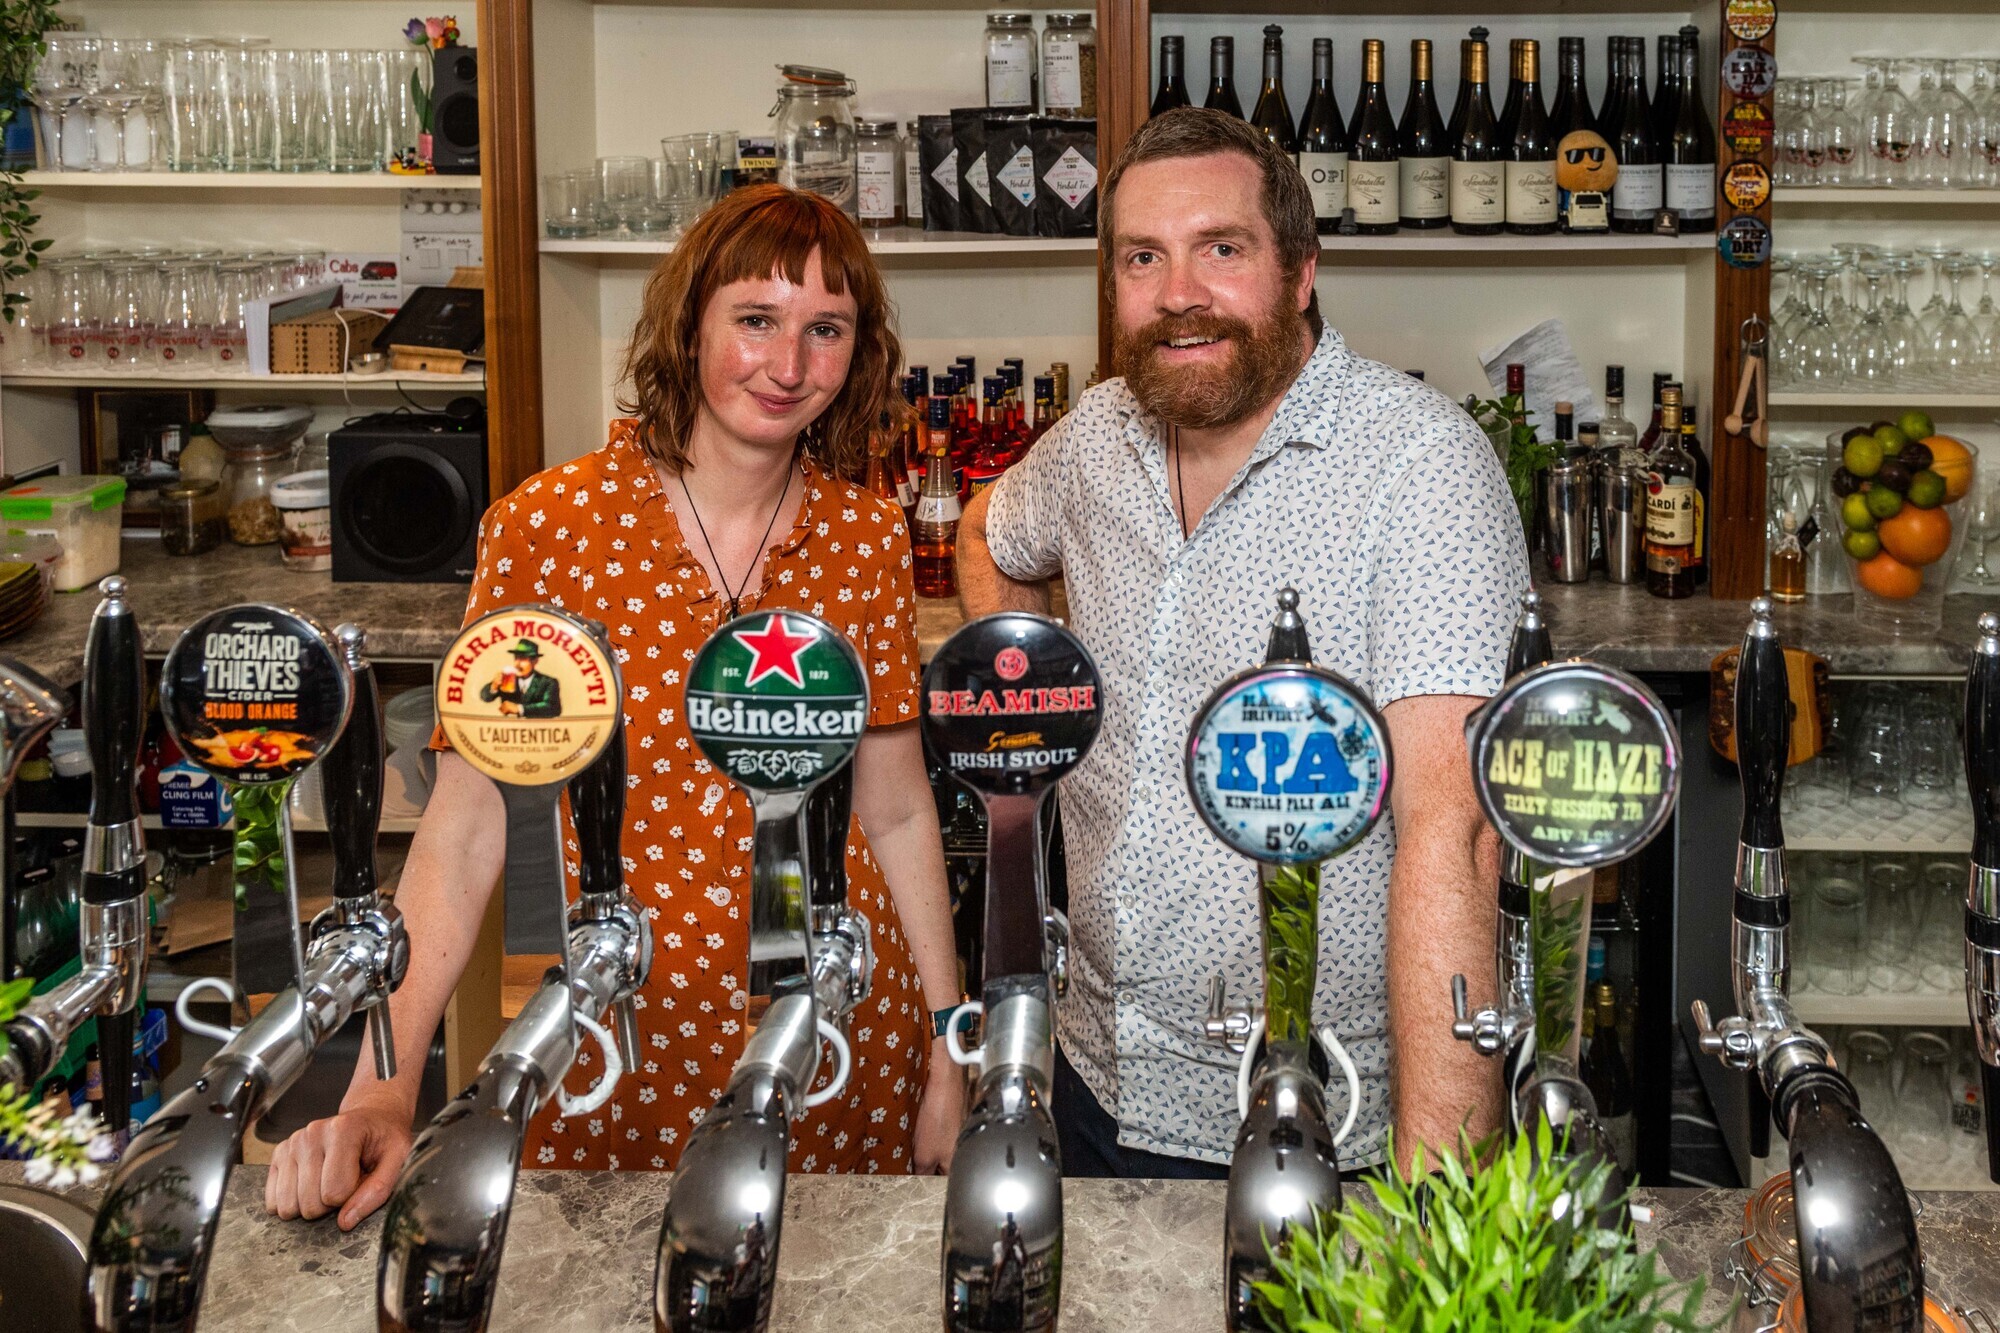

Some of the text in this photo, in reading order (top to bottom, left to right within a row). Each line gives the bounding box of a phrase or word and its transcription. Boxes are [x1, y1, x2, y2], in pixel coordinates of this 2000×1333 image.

[743, 159, 775, 167] TWINING
[1056, 180, 1078, 190] Herbal
[1737, 198, 1755, 206] IPA
[1727, 228, 1768, 240] SUPER
[1731, 240, 1763, 253] DRY
[1648, 498, 1676, 511] CARDÍ
[204, 633, 300, 660] ORCHARD
[447, 621, 607, 706] BIRRA MORETTI
[204, 661, 300, 690] THIEVES
[722, 667, 829, 680] EST. 1873
[227, 691, 273, 701] CIDER
[929, 685, 1096, 716] BEAMISH
[205, 703, 298, 719] BLOOD ORANGE
[687, 697, 865, 736] Heineken
[479, 726, 572, 744] L'AUTENTICA
[950, 748, 1077, 770] IRISH STOUT
[1216, 731, 1358, 795] KPA
[1489, 739, 1662, 795] ACE OF HAZE
[164, 781, 191, 789] REMIE
[162, 790, 214, 800] CLING FILM
[1225, 796, 1350, 812] KINSALE PALE ALE
[1503, 793, 1644, 821] HAZY SESSION IPA
[1266, 822, 1309, 850] 5%
[1531, 825, 1574, 843] ABV
